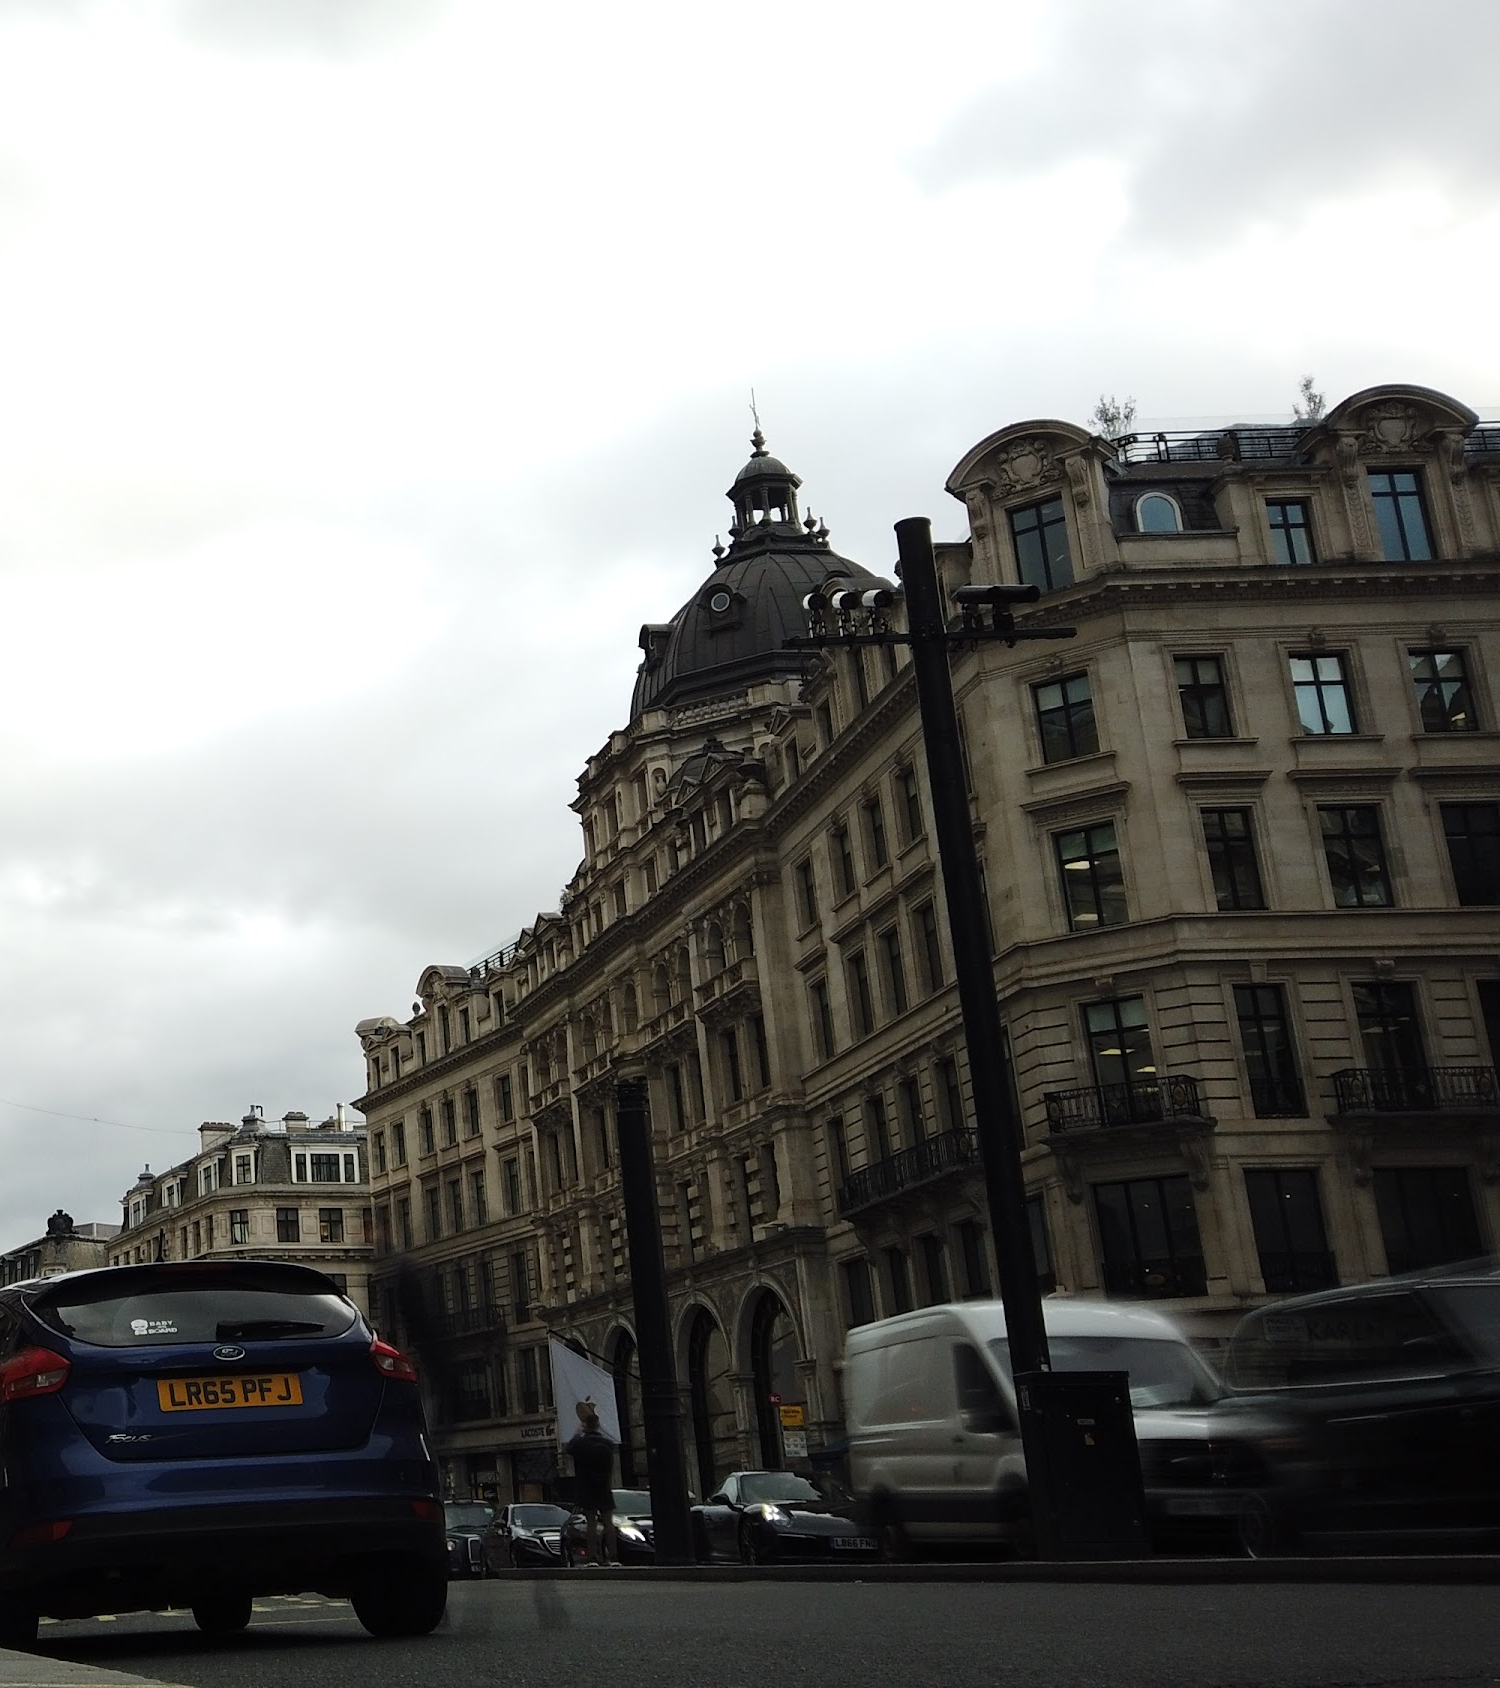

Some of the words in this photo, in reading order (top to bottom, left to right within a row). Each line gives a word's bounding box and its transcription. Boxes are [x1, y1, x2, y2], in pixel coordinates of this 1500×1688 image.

[147, 1327, 178, 1335] BOARD
[168, 1381, 236, 1407] LR65
[241, 1377, 292, 1403] PFJ
[521, 1427, 545, 1438] LACOSTE
